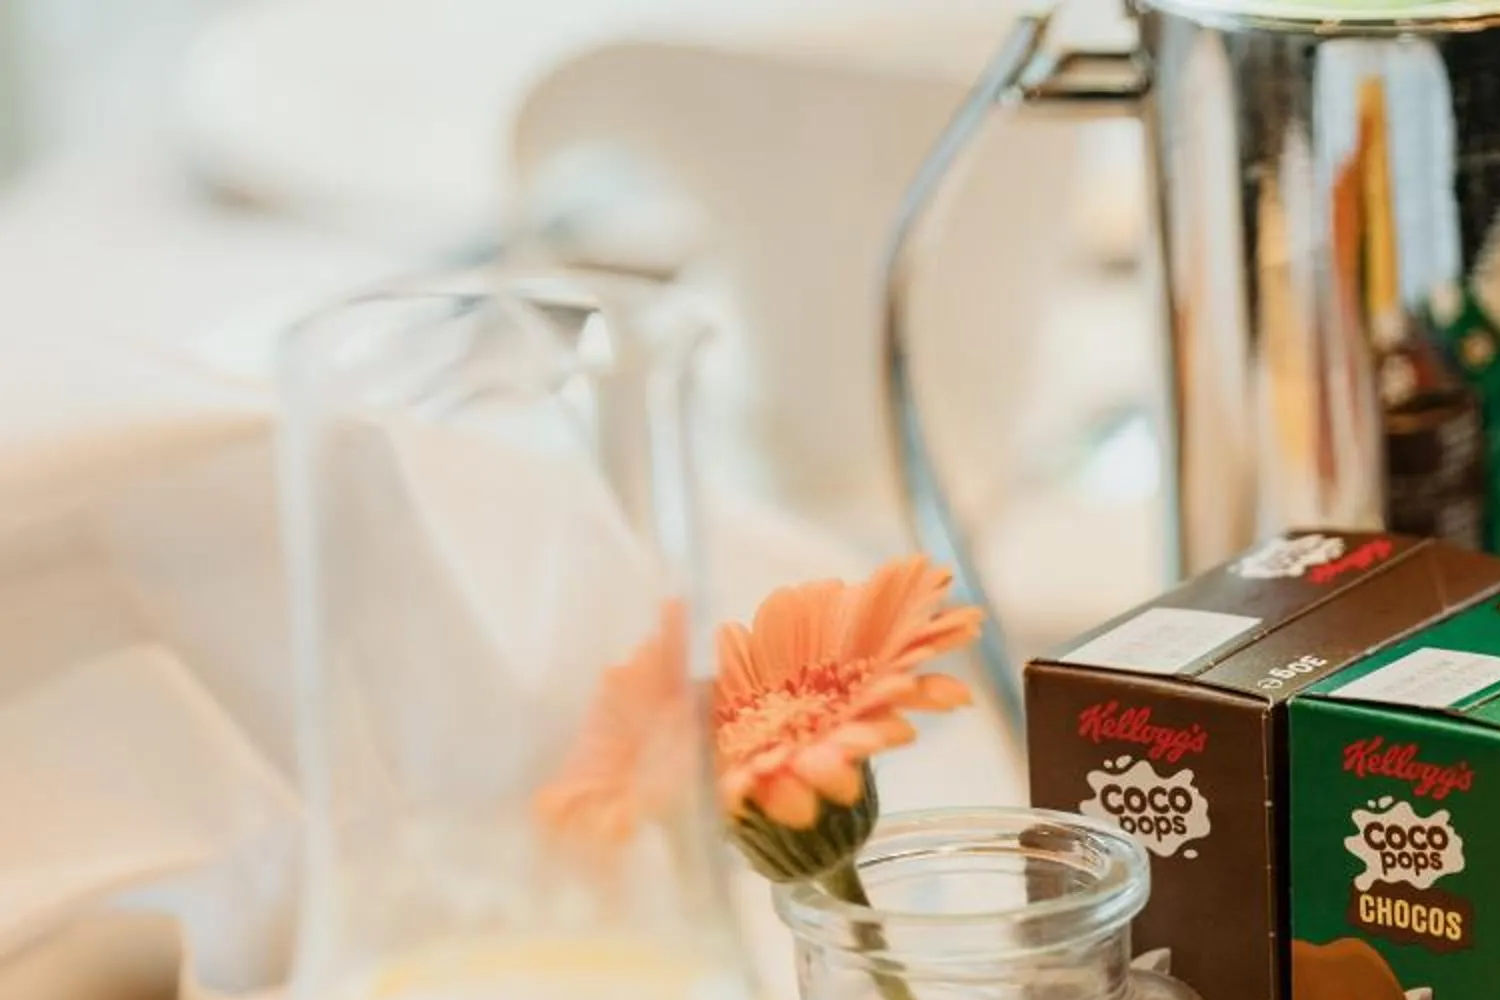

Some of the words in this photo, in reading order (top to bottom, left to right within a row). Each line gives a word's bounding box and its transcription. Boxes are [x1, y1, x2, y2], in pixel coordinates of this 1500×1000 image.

[1079, 701, 1208, 762] Kellogg's
[1343, 736, 1474, 799] Kellogg's
[1380, 851, 1443, 876] pops
[1359, 894, 1462, 940] CHOCOS
